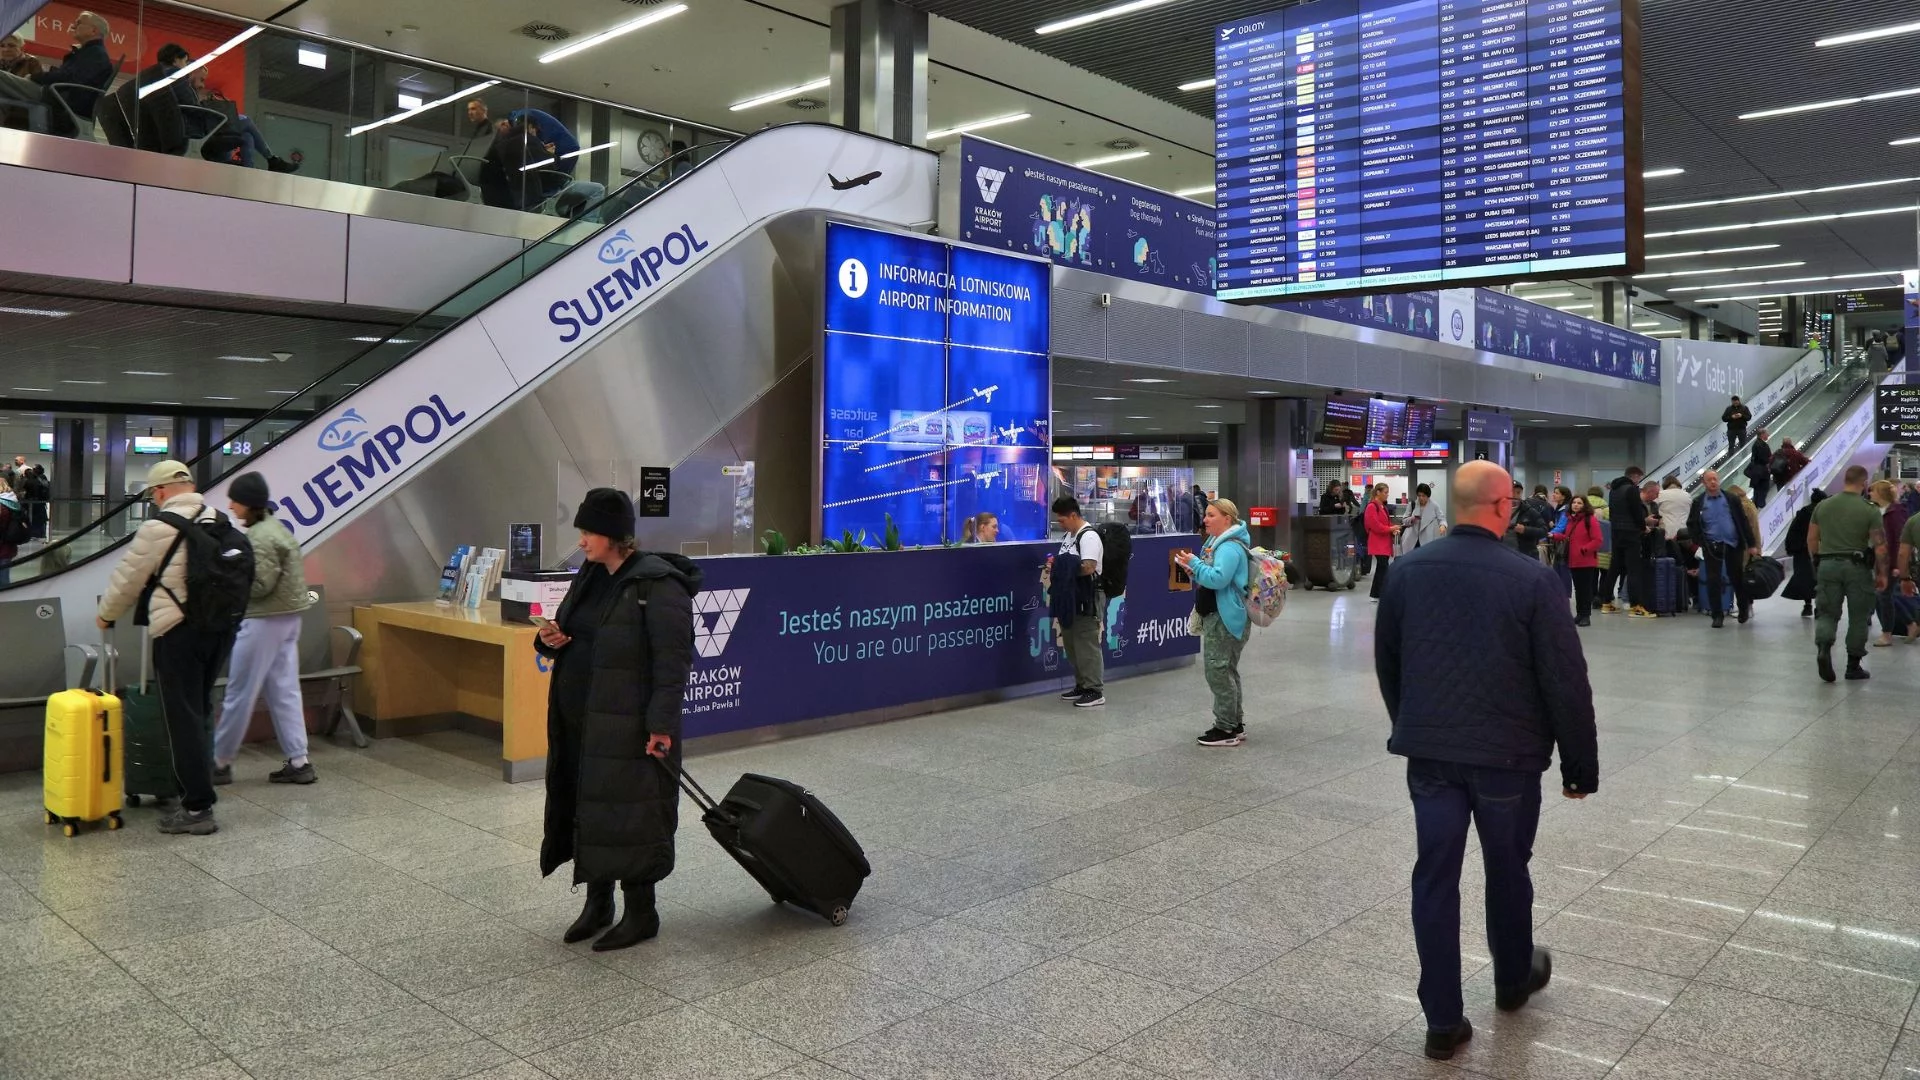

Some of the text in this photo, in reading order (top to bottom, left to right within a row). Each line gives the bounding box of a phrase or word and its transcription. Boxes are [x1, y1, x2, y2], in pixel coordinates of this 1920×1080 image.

[1573, 6, 1605, 17] OCZEKIWANY
[1238, 22, 1265, 35] ODLOTY
[1573, 18, 1605, 28] OCZEKIWANY
[38, 16, 124, 44] KRAW
[1573, 30, 1605, 40] OCZEKIWANY
[1574, 54, 1606, 64] OCZEKIWANY
[1574, 65, 1606, 75] OCZEKIWANY
[1483, 94, 1510, 102] BARCELONA
[1574, 77, 1606, 87] OCZEKIWANY
[1574, 89, 1606, 99] OCZEKIWANY
[1575, 102, 1607, 111] OCZEKIWANY
[1575, 114, 1607, 123] OCZEKIWANY
[1575, 126, 1607, 135] OCZEKIWANY
[1575, 137, 1607, 147] OCZEKIWANY
[1575, 150, 1607, 158] OCZEKIWANY
[1575, 162, 1608, 170] OCZEKIWANY
[1027, 168, 1098, 194] Jesteś naszym pasażerem!
[1576, 174, 1608, 182] OCZEKIWANY
[1132, 197, 1161, 212] Dogoterapia
[1576, 198, 1608, 206] OCZEKIWANY
[975, 207, 1002, 218] KRAKÓW
[1130, 209, 1140, 220] Dog
[974, 215, 1002, 227] AIRPORT
[549, 224, 708, 342] SUEMPOL
[880, 263, 1030, 301] INFORMACJA LOTNISKOWA
[879, 290, 1011, 322] AIRPORT INFORMATION
[1705, 358, 1725, 394] Gate
[233, 442, 251, 454] 38
[779, 591, 1014, 636] Jesteś naszym pasażerem!
[814, 620, 1014, 664] You are our passenger!
[686, 664, 741, 685] RAKÓW
[693, 703, 710, 713] Jana
[712, 700, 732, 711] Pawła
